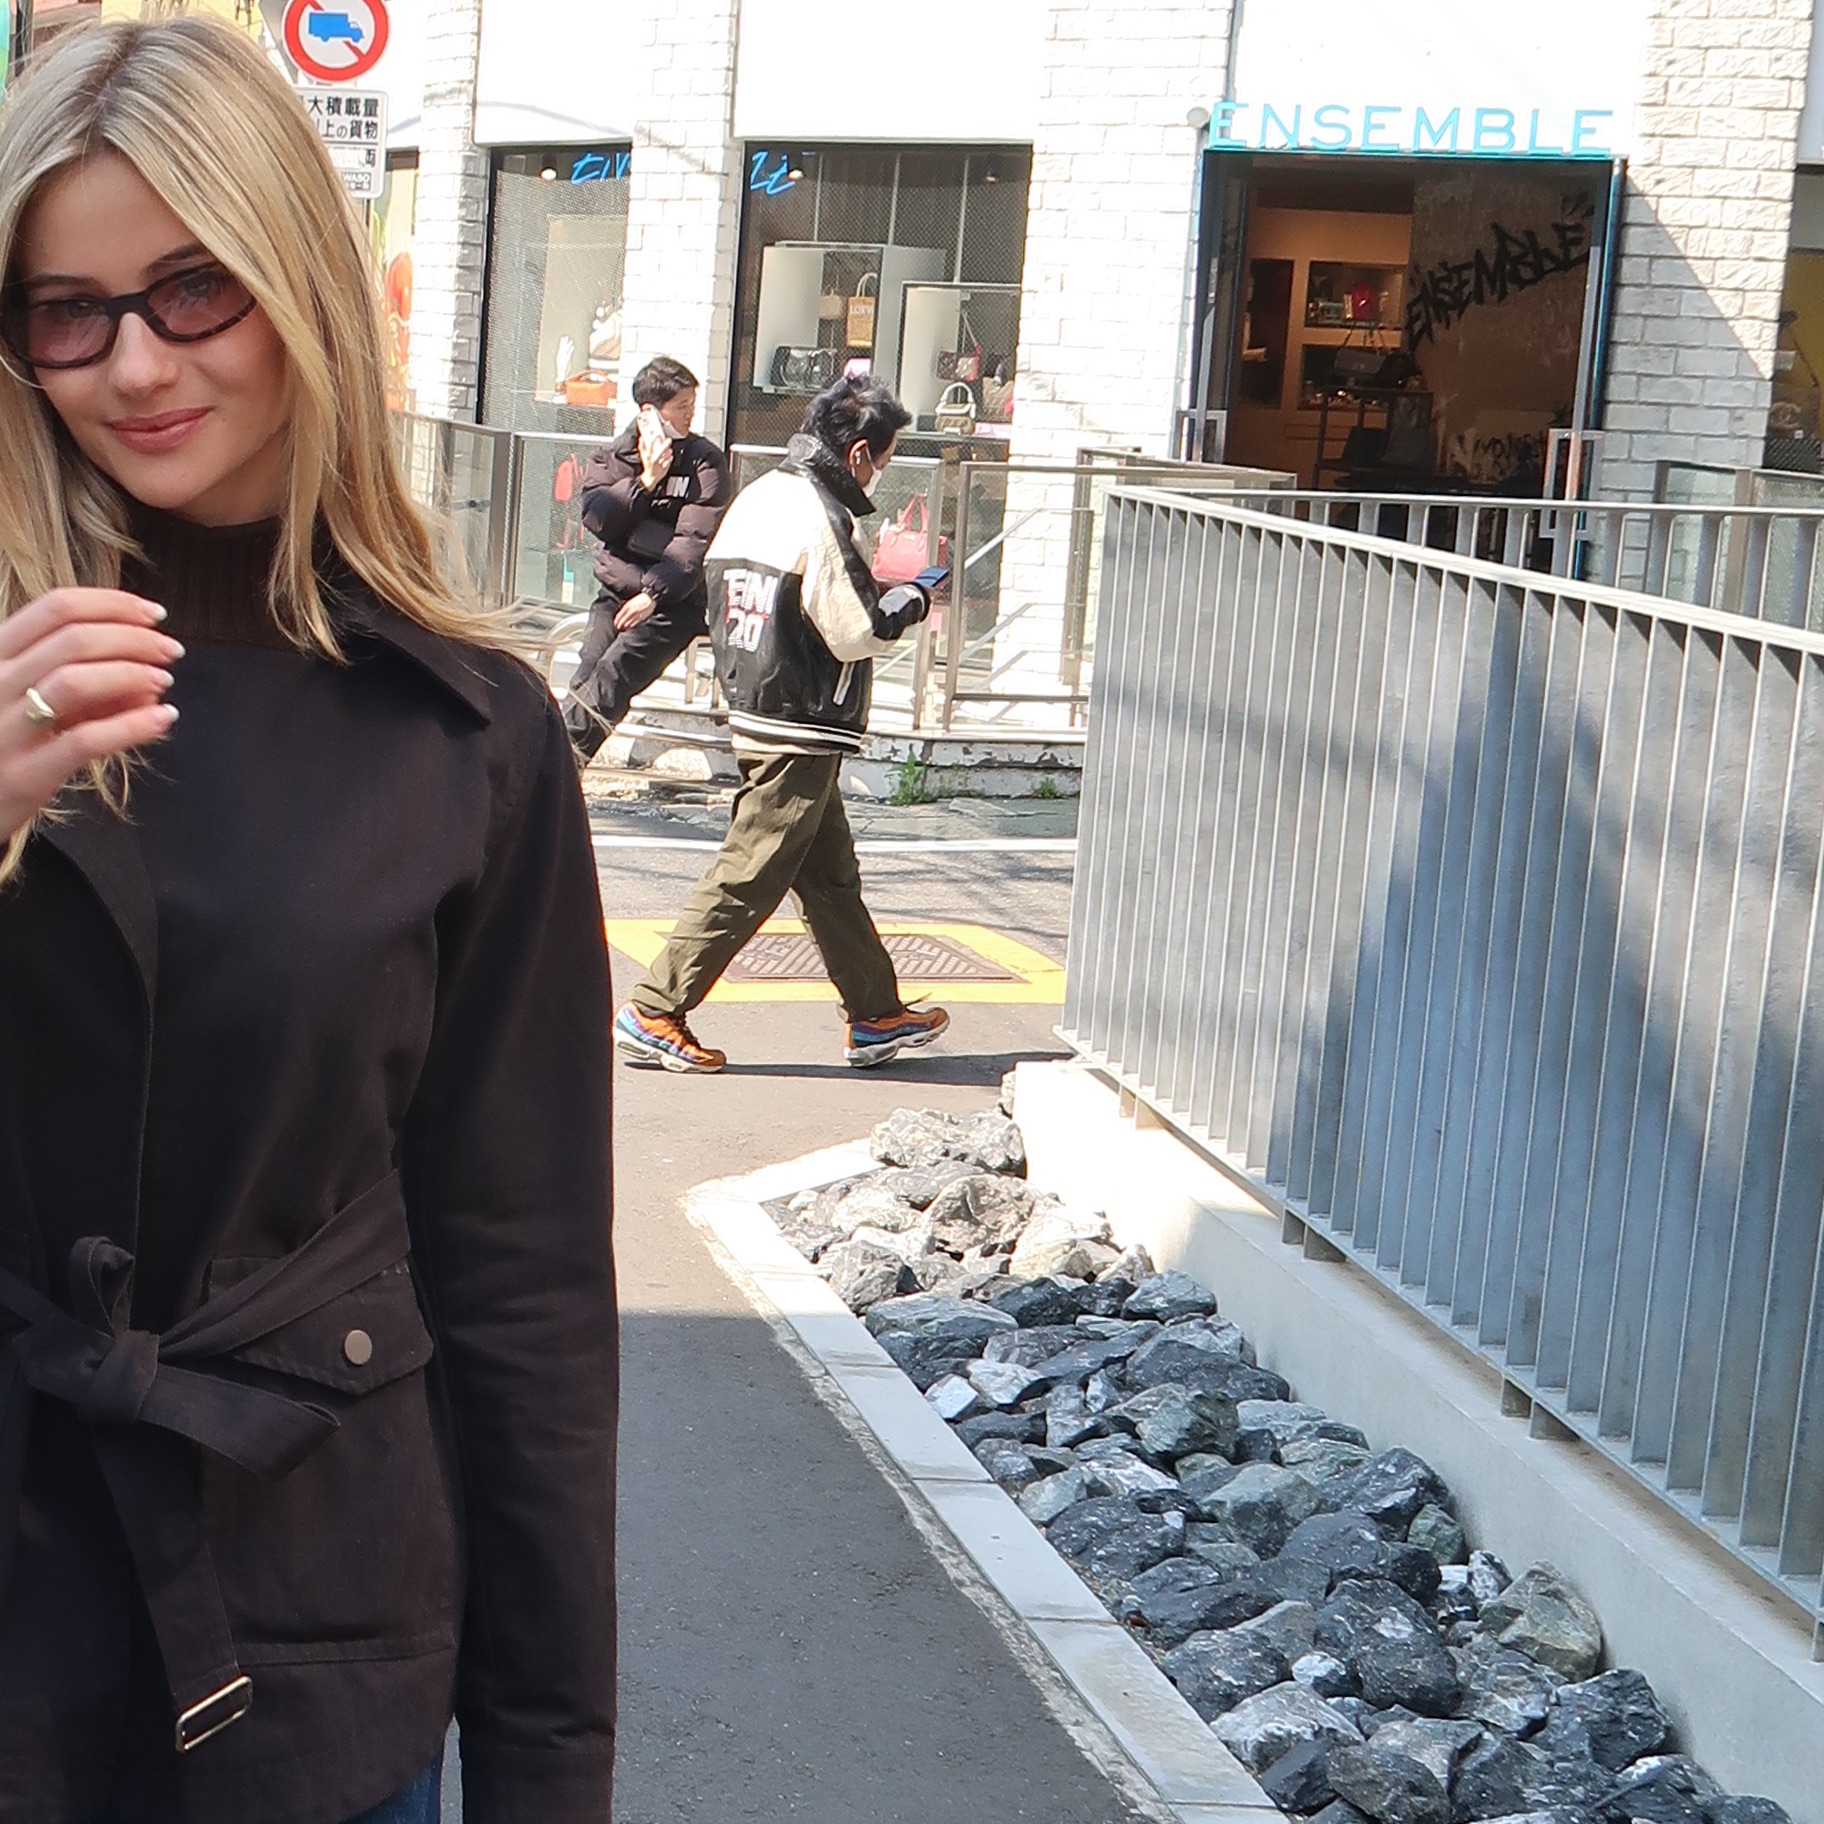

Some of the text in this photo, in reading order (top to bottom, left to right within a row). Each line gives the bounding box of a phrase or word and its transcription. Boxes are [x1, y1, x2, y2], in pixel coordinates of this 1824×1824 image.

[299, 96, 379, 117] 大積載量
[316, 119, 379, 139] 上の貨物
[1208, 101, 1614, 159] ENSEMBLE
